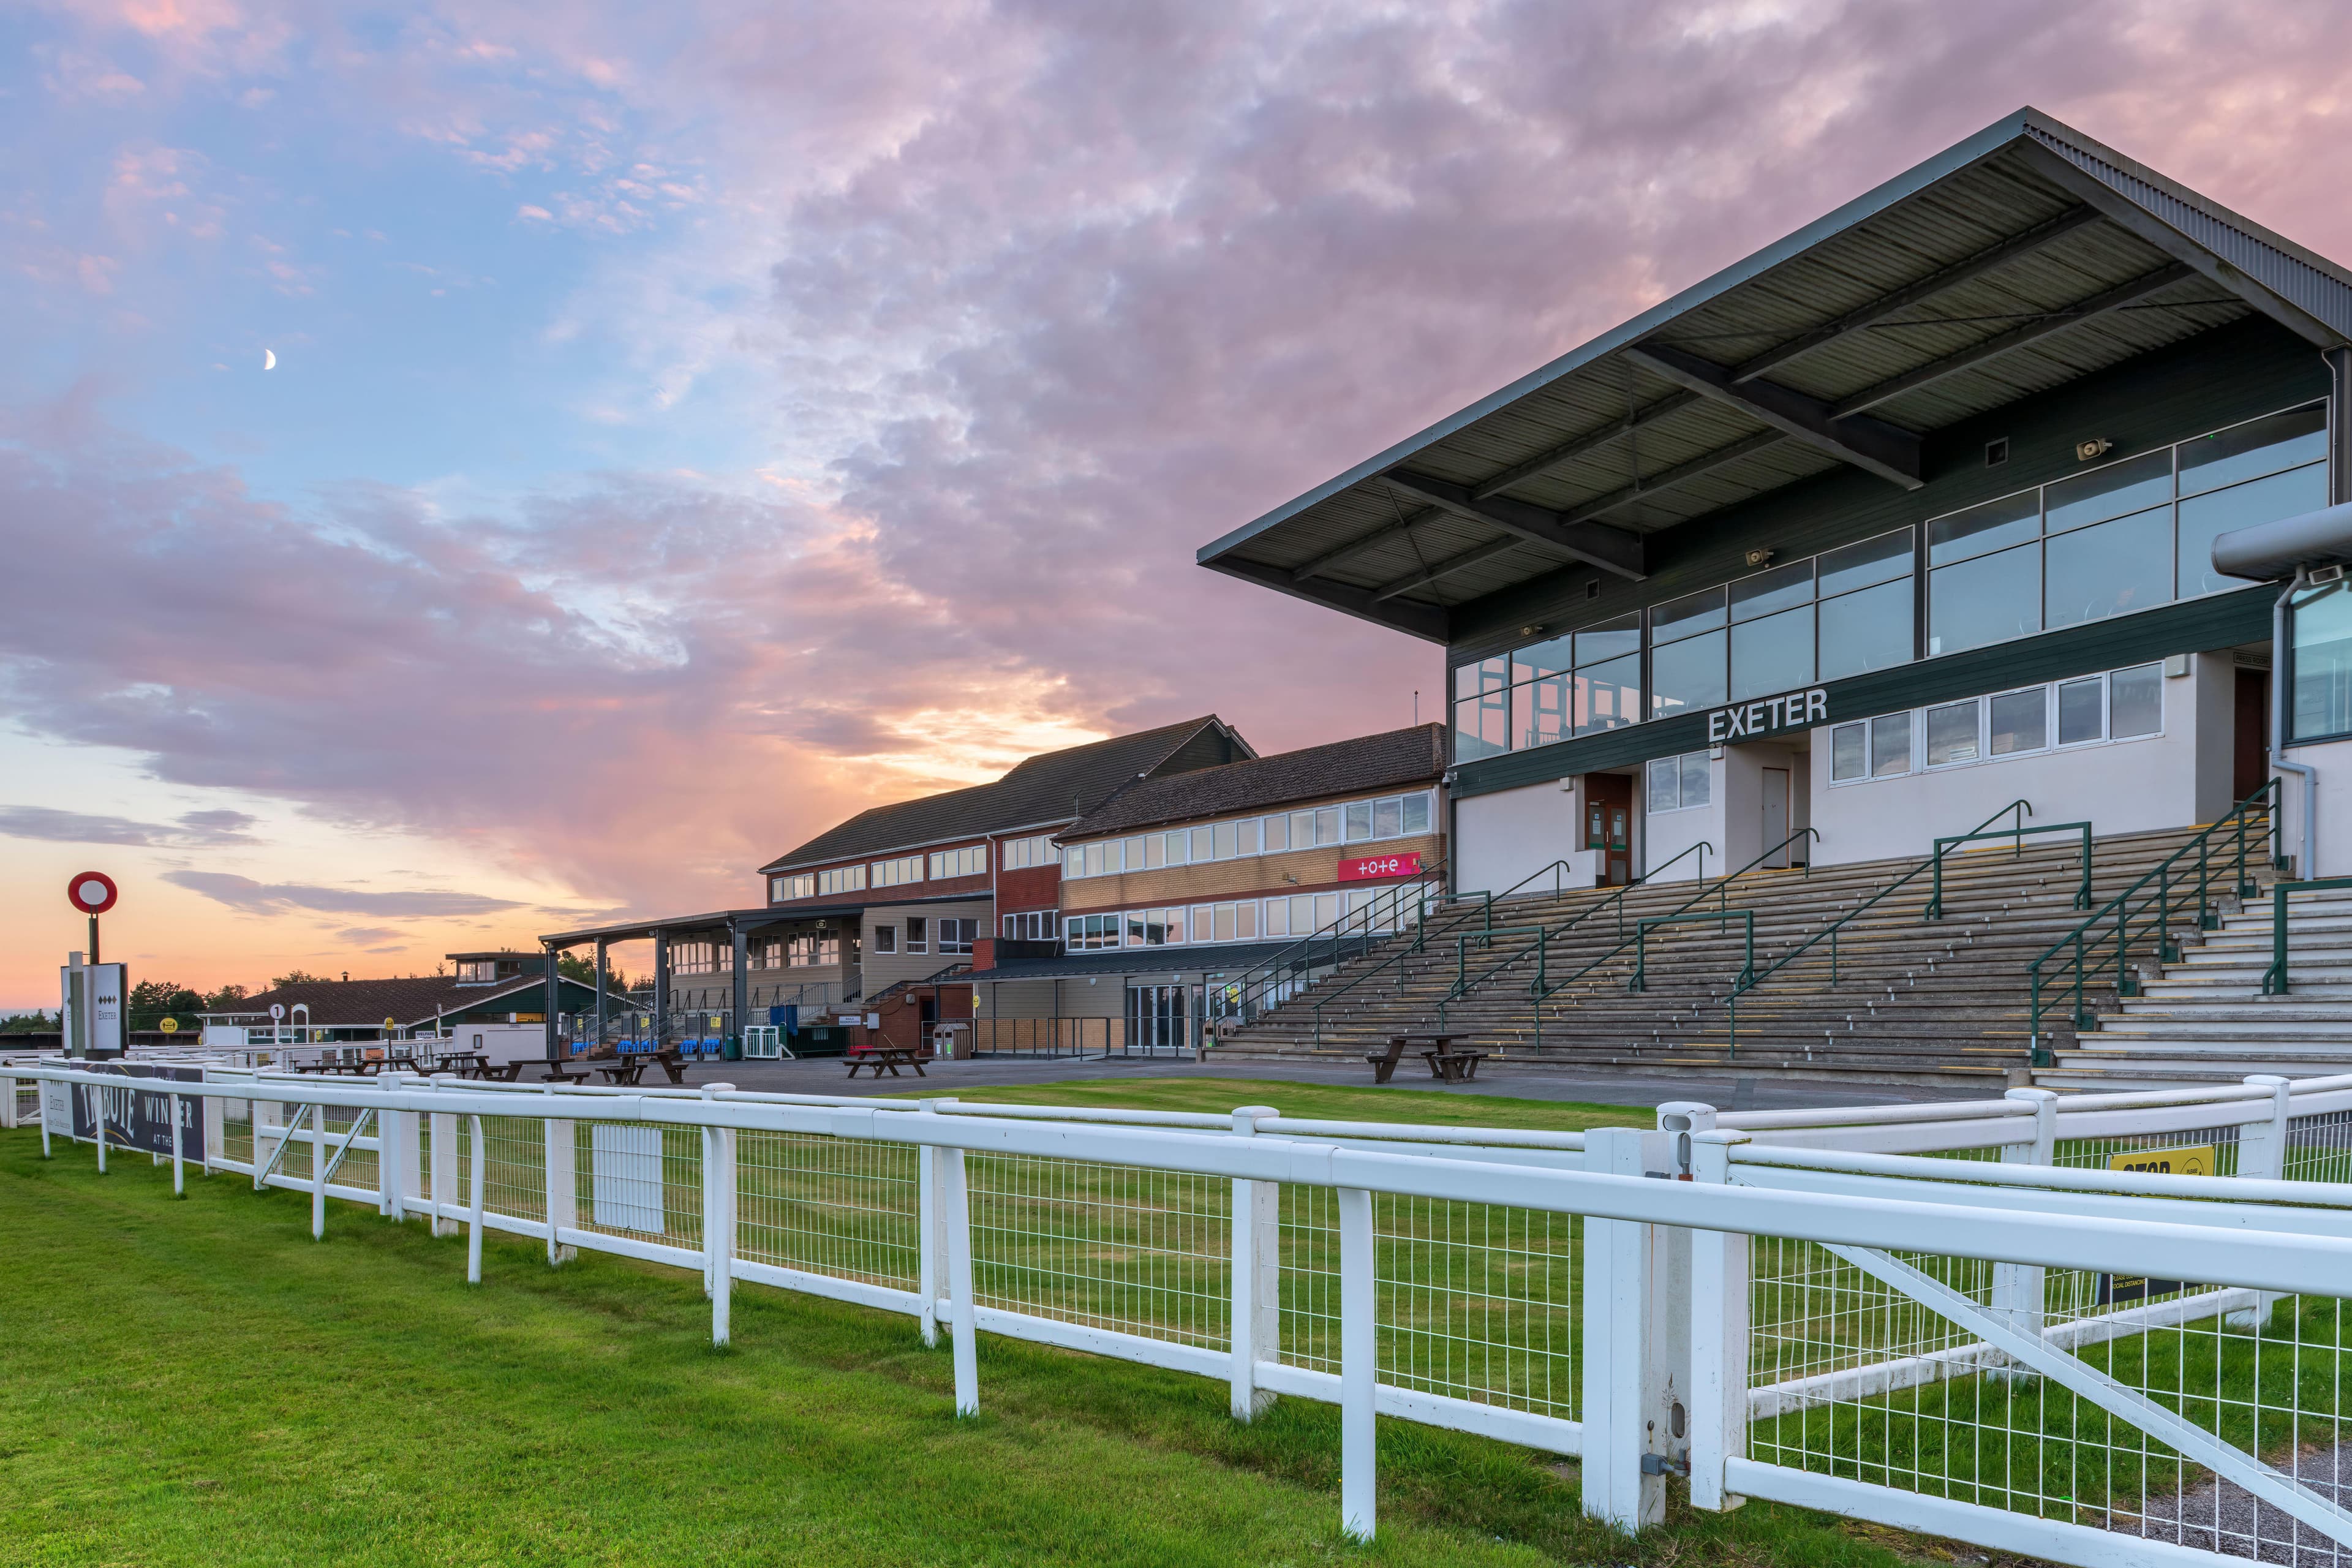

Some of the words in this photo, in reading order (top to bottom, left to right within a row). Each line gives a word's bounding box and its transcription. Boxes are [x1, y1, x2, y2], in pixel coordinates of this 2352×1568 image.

[2236, 654, 2252, 663] PRESS
[1709, 689, 1828, 742] EXETER
[1359, 859, 1398, 875] tote
[274, 1006, 279, 1017] 1
[80, 1084, 135, 1139] TRBUTE
[145, 1096, 193, 1128] WINER
[153, 1133, 160, 1145] AT
[162, 1135, 172, 1147] THE
[2125, 1278, 2146, 1287] DISTANCING
